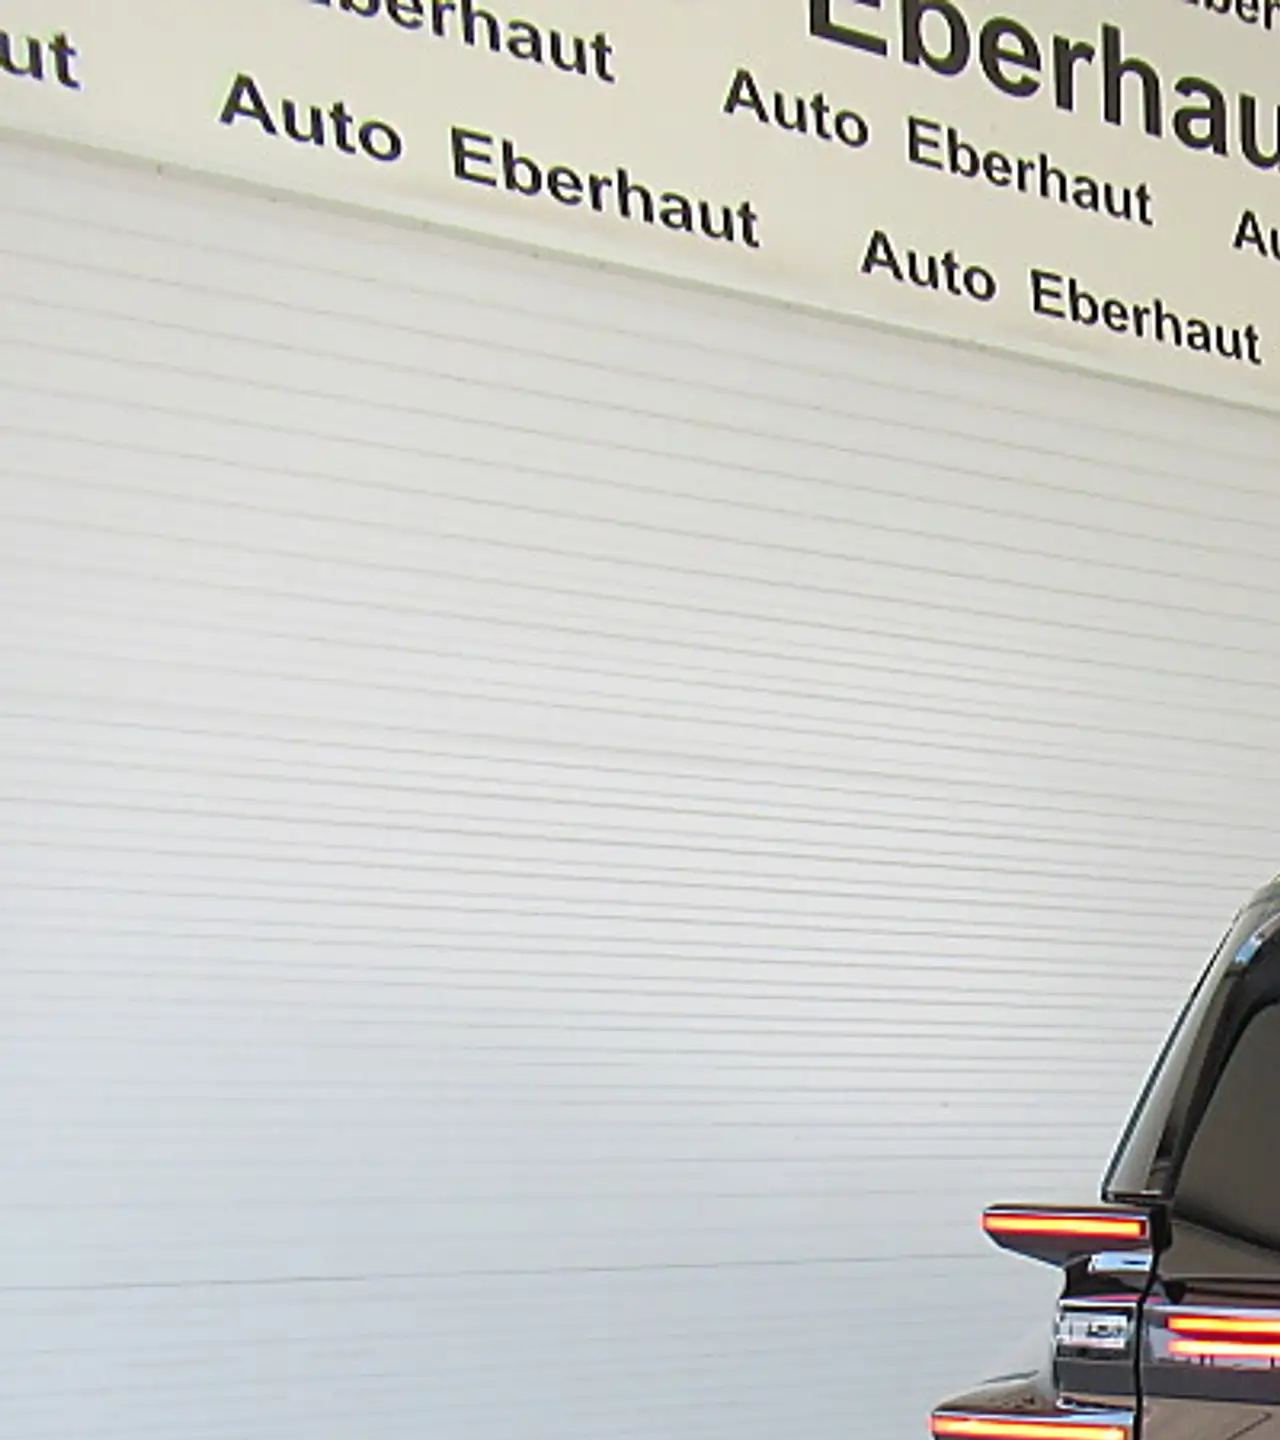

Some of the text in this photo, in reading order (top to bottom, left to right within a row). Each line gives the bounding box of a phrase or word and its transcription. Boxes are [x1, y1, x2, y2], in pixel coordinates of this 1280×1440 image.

[220, 74, 401, 161] Auto
[451, 126, 759, 248] Eberhaut
[862, 230, 996, 301] Auto
[1031, 269, 1261, 365] Eberhaut
[310, 0, 614, 83] erhaut
[724, 69, 868, 148] Auto
[908, 116, 1152, 226] Eberhaut
